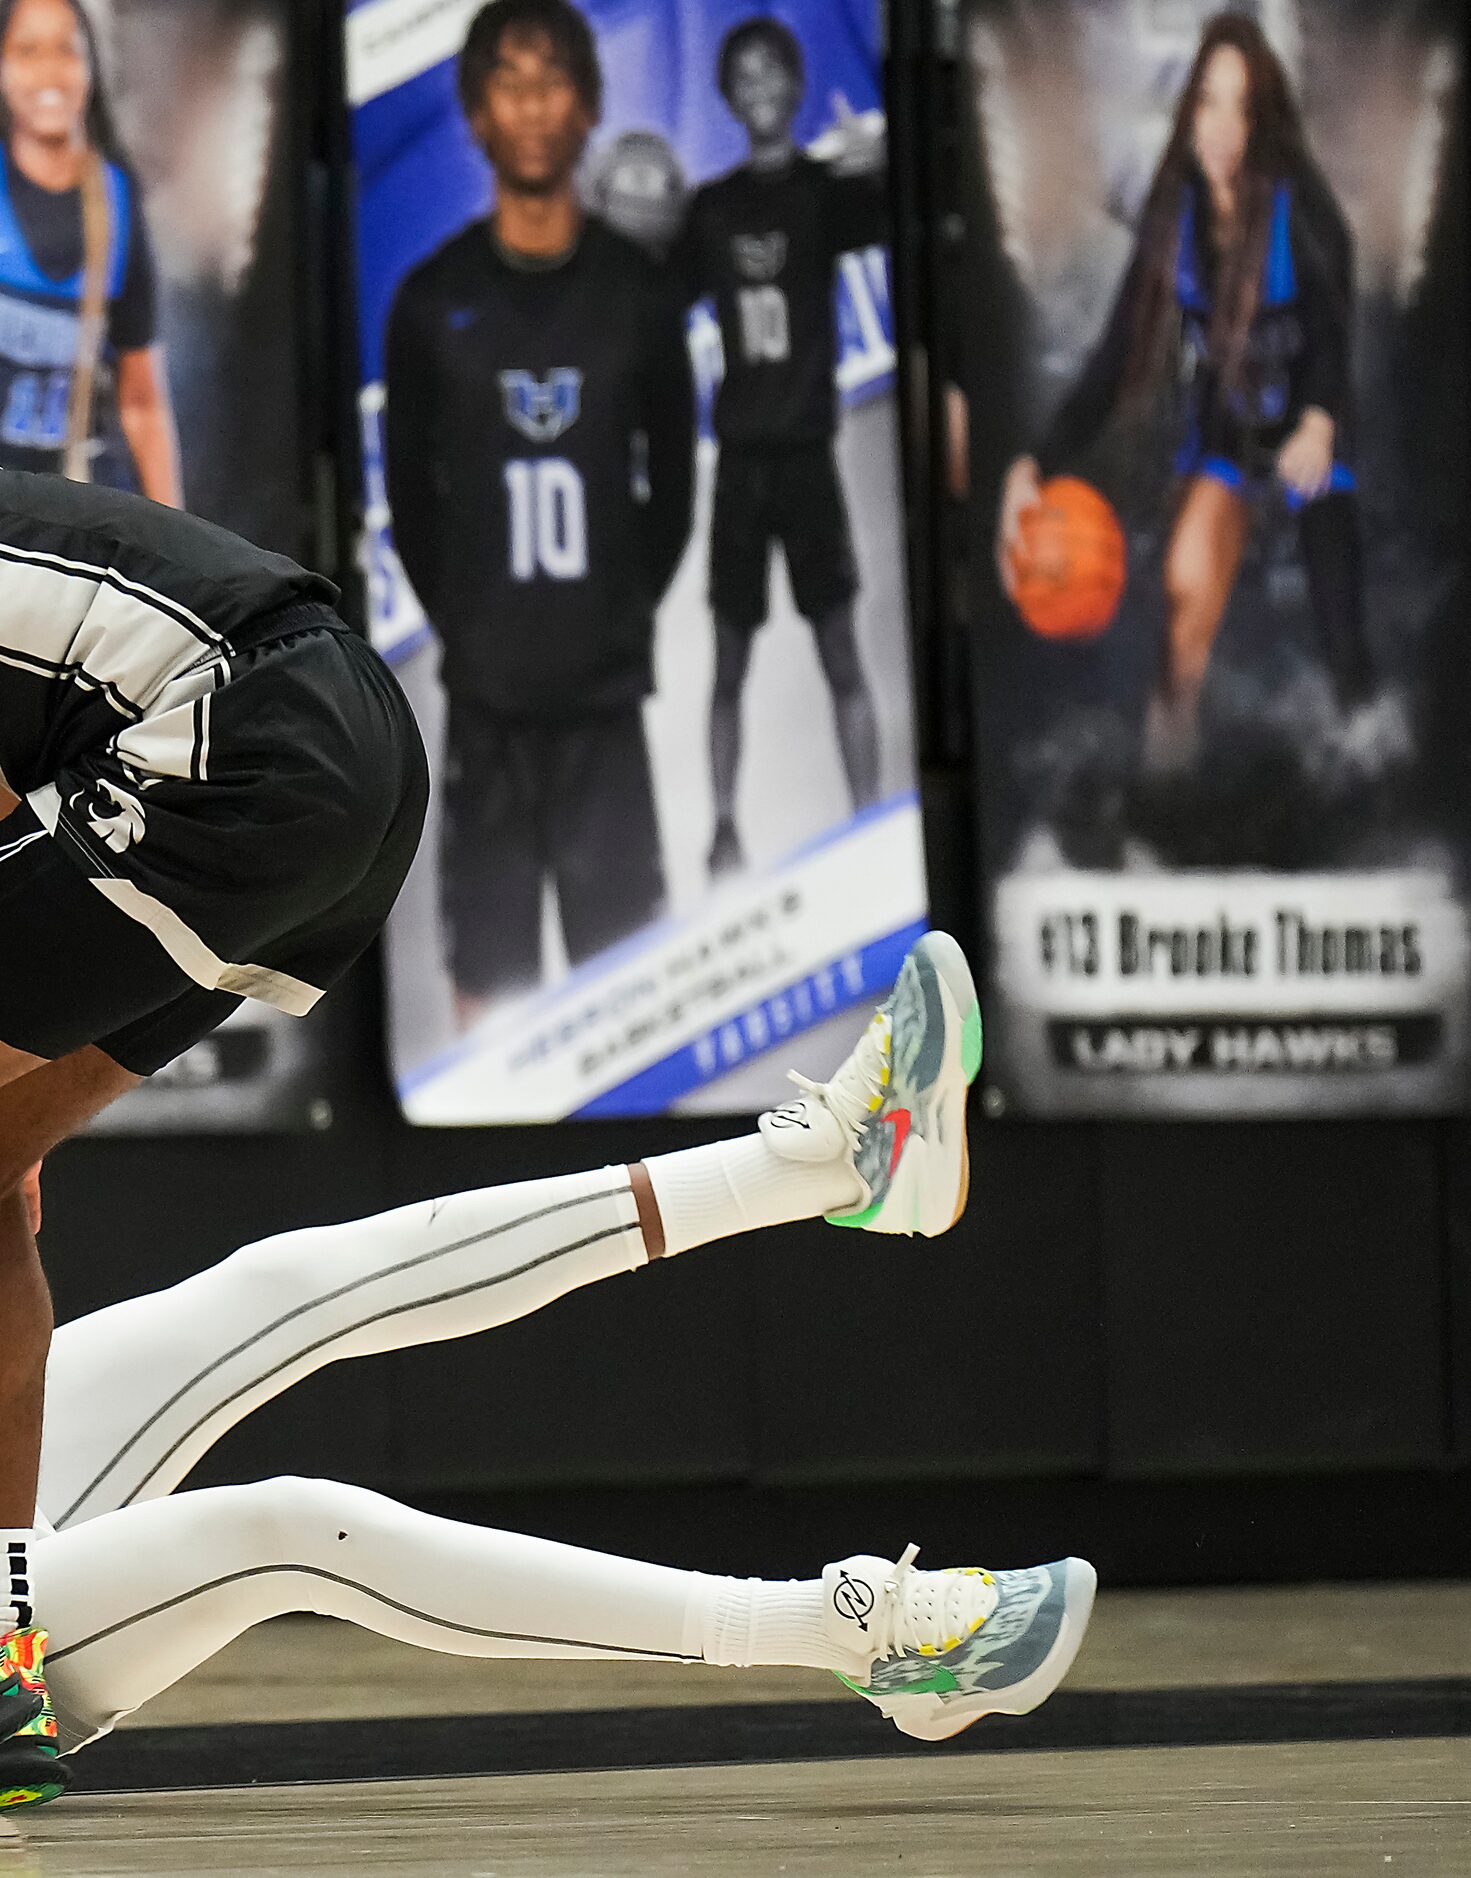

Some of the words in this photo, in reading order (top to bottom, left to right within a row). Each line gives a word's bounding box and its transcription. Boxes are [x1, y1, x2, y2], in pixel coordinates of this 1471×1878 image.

[504, 456, 588, 580] 10
[1116, 910, 1258, 977] Brooke
[1272, 908, 1423, 977] Thomas
[1073, 1026, 1198, 1072] LADY
